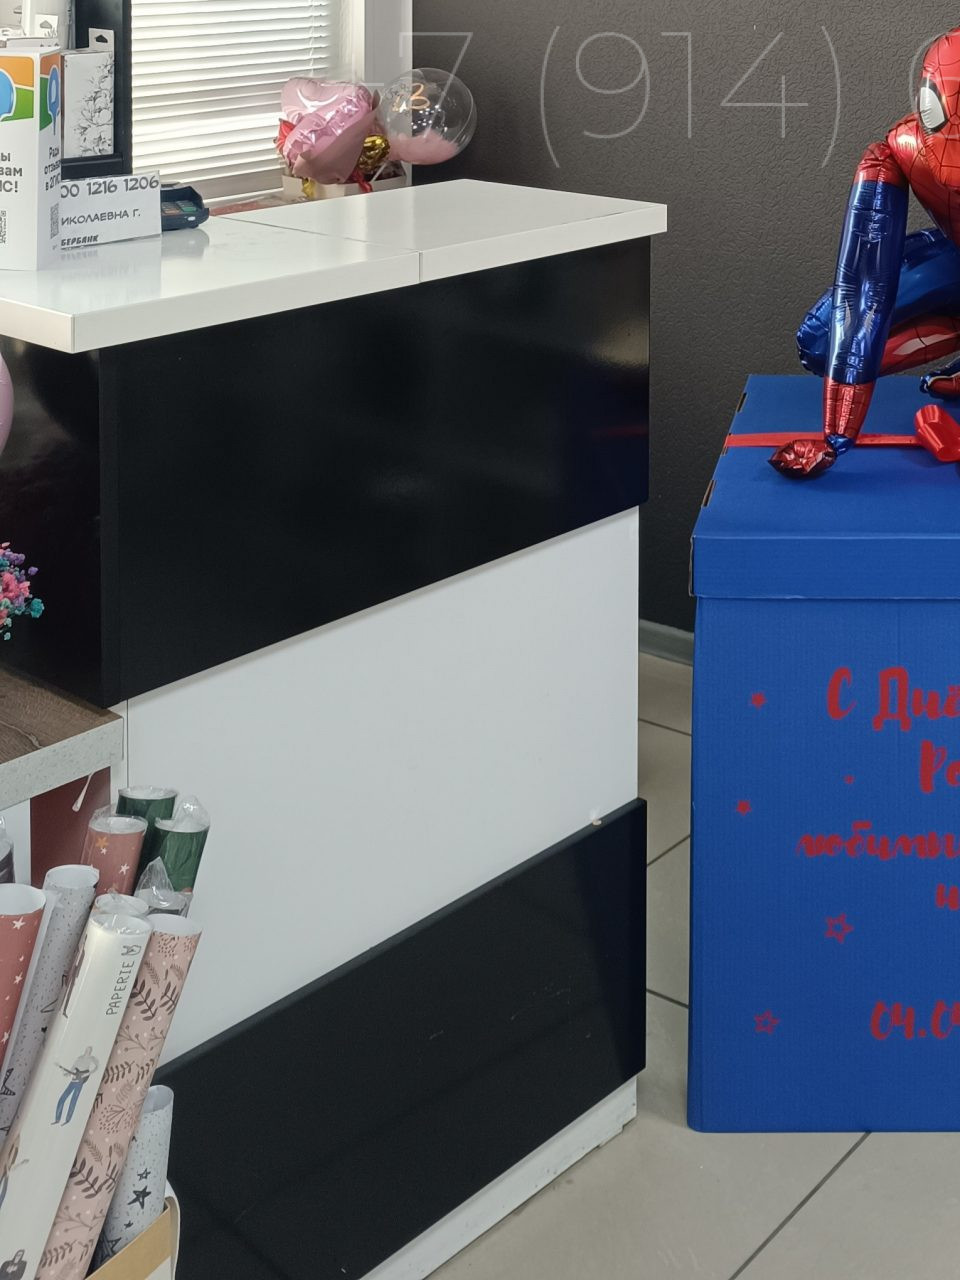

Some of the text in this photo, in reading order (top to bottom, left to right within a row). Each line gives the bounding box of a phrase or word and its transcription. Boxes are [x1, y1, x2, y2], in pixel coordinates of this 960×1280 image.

[86, 179, 118, 196] 1216
[123, 175, 160, 192] 1206
[827, 667, 855, 720] С
[105, 960, 136, 1016] PAPERIE
